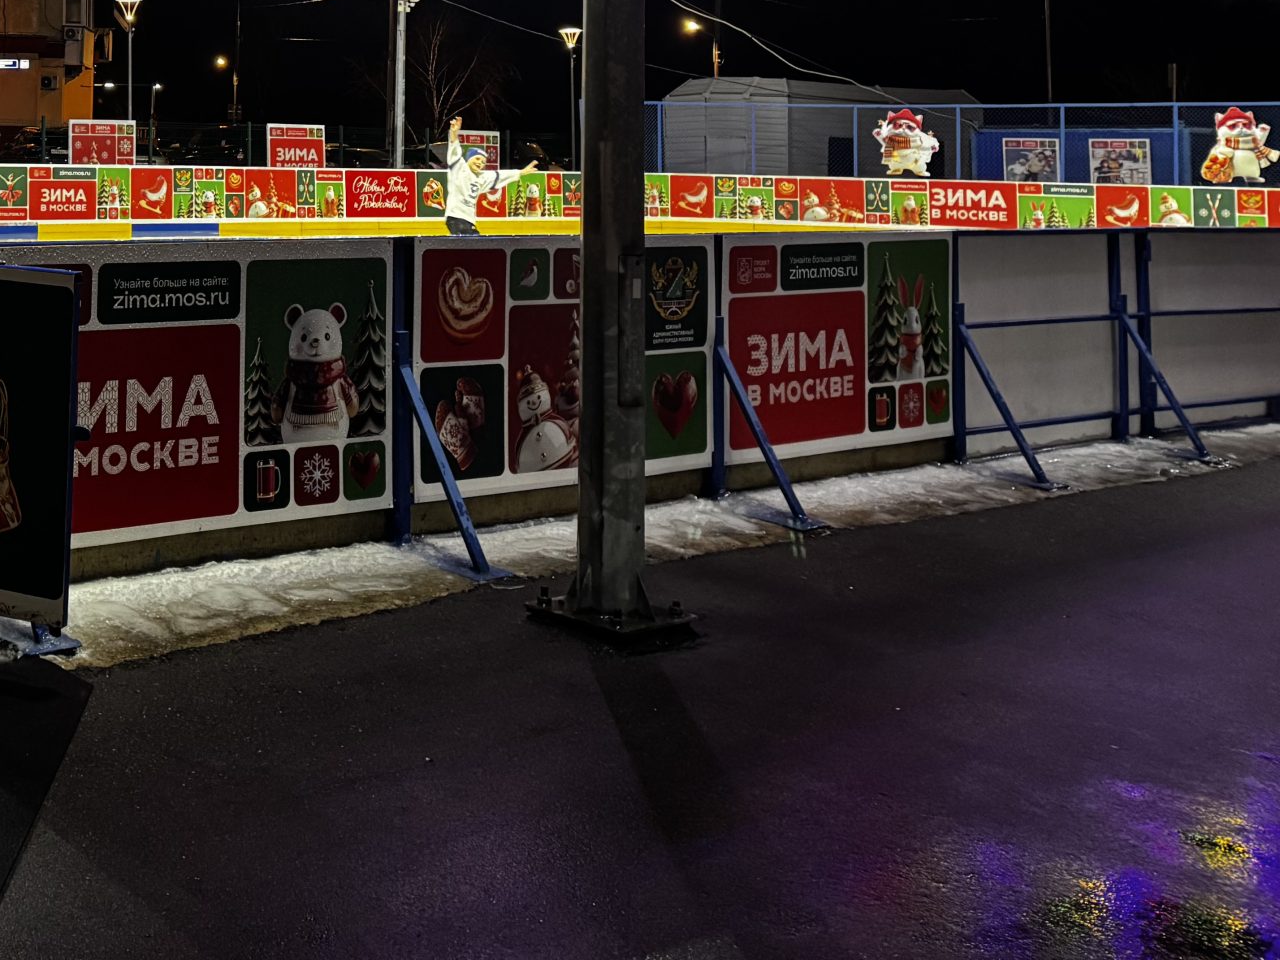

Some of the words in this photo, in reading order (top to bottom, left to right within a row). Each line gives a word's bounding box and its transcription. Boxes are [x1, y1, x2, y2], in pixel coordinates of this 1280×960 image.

[276, 147, 319, 161] ЗИМА
[59, 169, 91, 177] zima.mos.ru
[40, 188, 87, 203] ЗИМА
[1050, 186, 1088, 194] zima.mos.ru
[931, 188, 1008, 209] ЗИМА
[40, 204, 47, 212] В
[49, 204, 87, 212] МОСКВЕ
[932, 209, 940, 219] В
[945, 209, 1008, 222] МОСКВЕ
[789, 265, 858, 280] zima.mos.ru
[113, 277, 151, 289] Узнайте
[153, 277, 187, 288] больше
[189, 279, 200, 287] на
[202, 276, 229, 287] сайте:
[113, 291, 229, 309] zima.mos.ru
[746, 328, 854, 377] ЗИМА
[747, 384, 762, 407] В
[769, 374, 854, 405] МОСКВЕ
[76, 374, 220, 434] ИМА
[72, 435, 220, 478] МОСКВЕ
